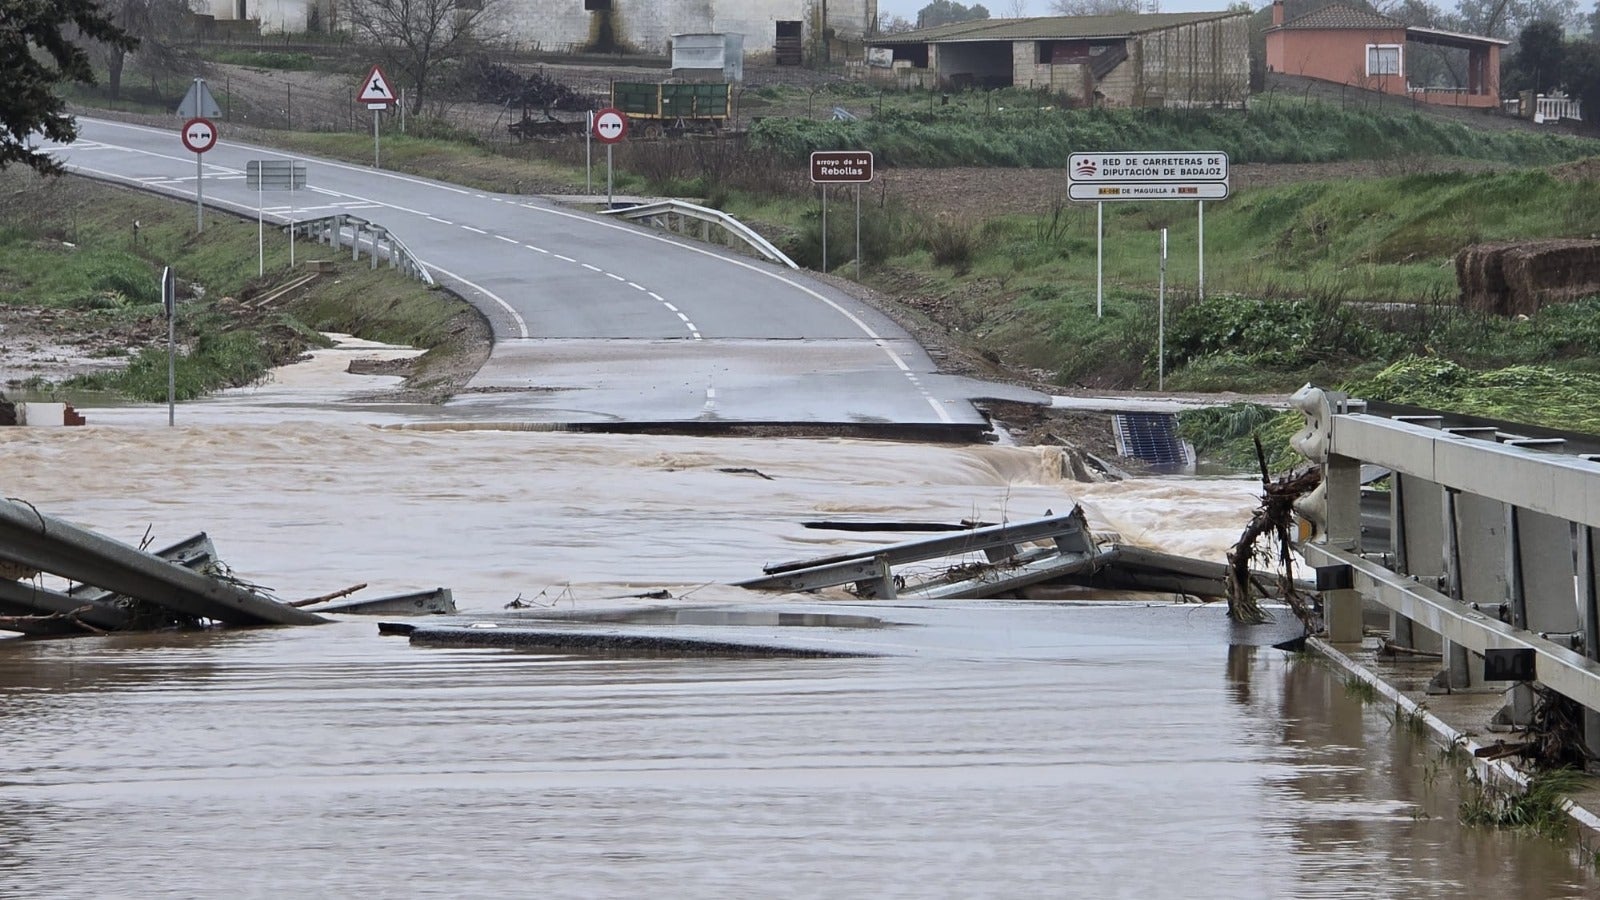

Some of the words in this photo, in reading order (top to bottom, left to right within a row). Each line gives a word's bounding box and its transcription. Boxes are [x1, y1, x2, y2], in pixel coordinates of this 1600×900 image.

[1102, 158, 1121, 166] RED
[1125, 158, 1138, 166] DE
[1142, 158, 1203, 166] CARRETERAS
[1207, 157, 1220, 165] DE
[821, 167, 863, 175] Rebollas
[1102, 167, 1159, 176] DIPUTACIÓN
[1163, 168, 1176, 176] DE
[1180, 168, 1221, 176] BADAJOZ
